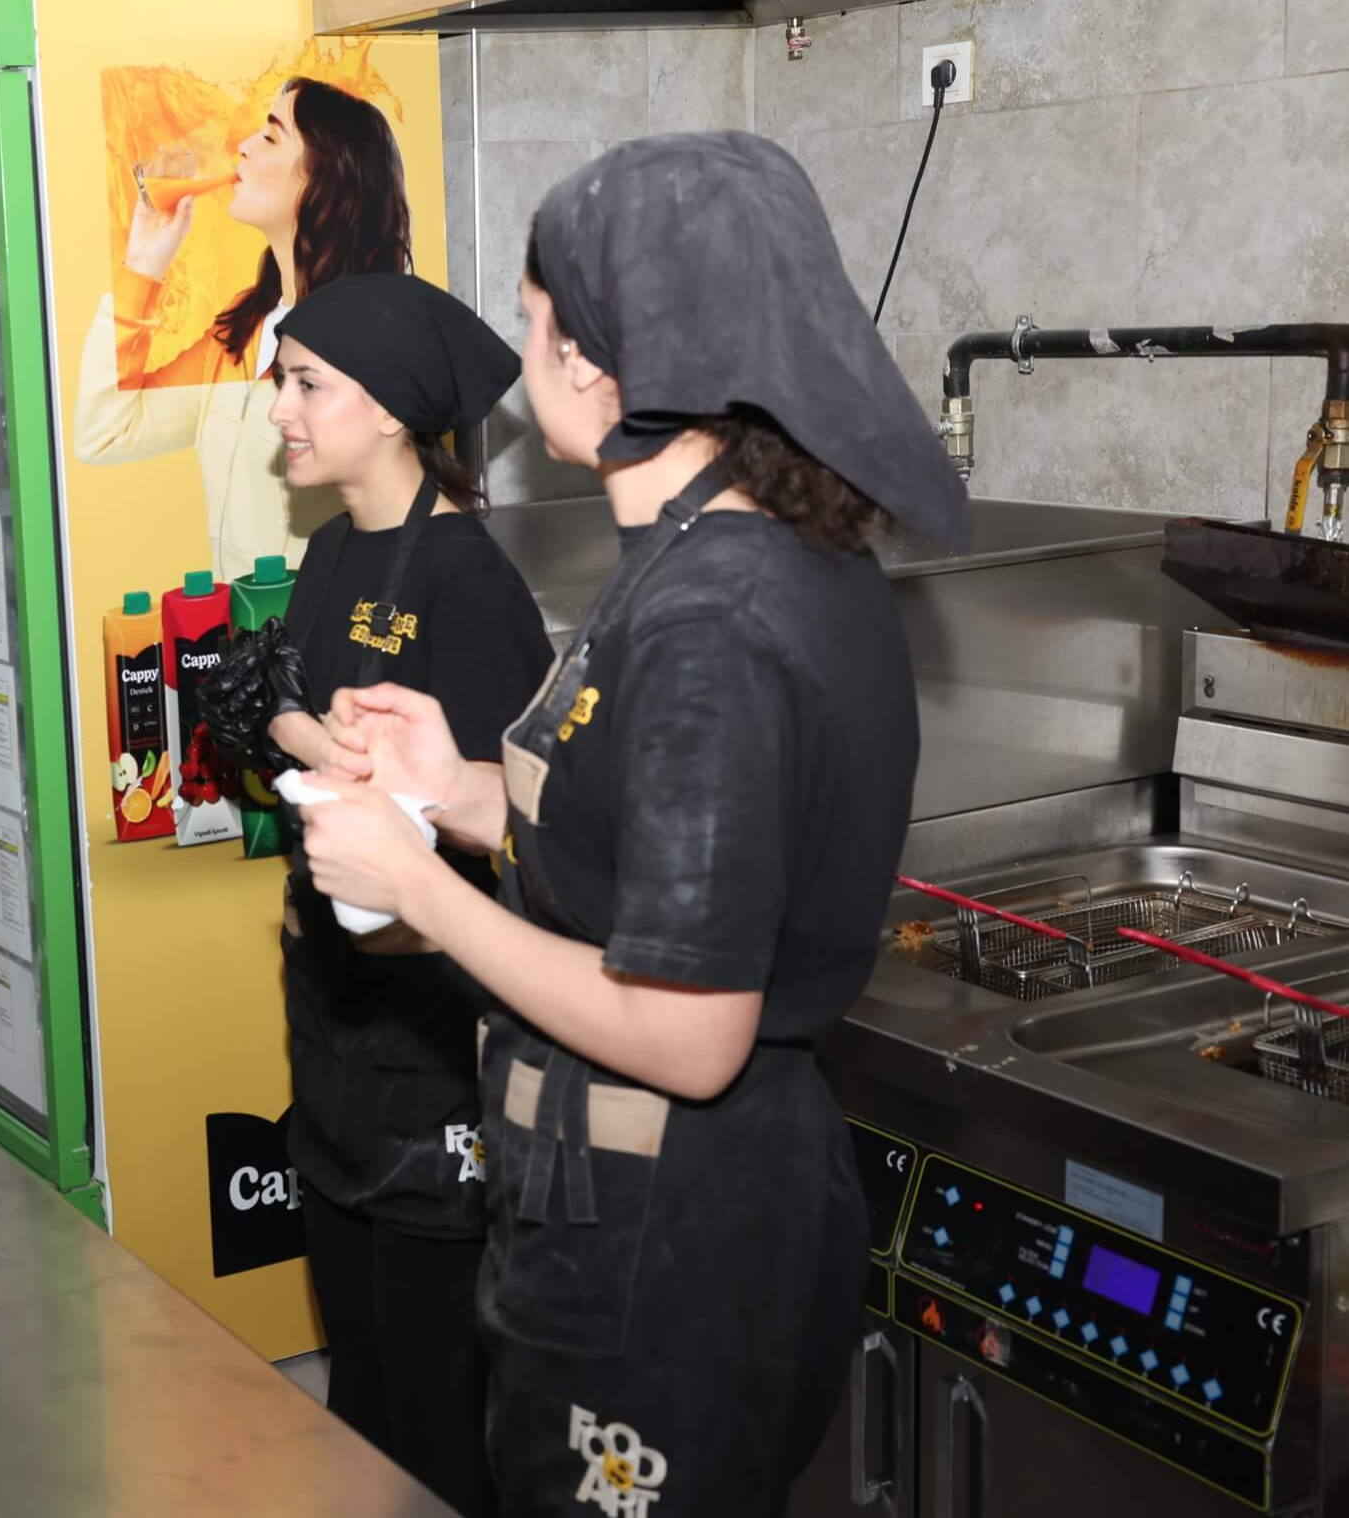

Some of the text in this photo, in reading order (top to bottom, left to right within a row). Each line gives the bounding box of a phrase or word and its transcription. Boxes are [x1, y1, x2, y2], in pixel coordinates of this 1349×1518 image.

[122, 668, 159, 684] Cappy
[130, 685, 154, 696] Destek
[568, 1402, 668, 1489] FOOD
